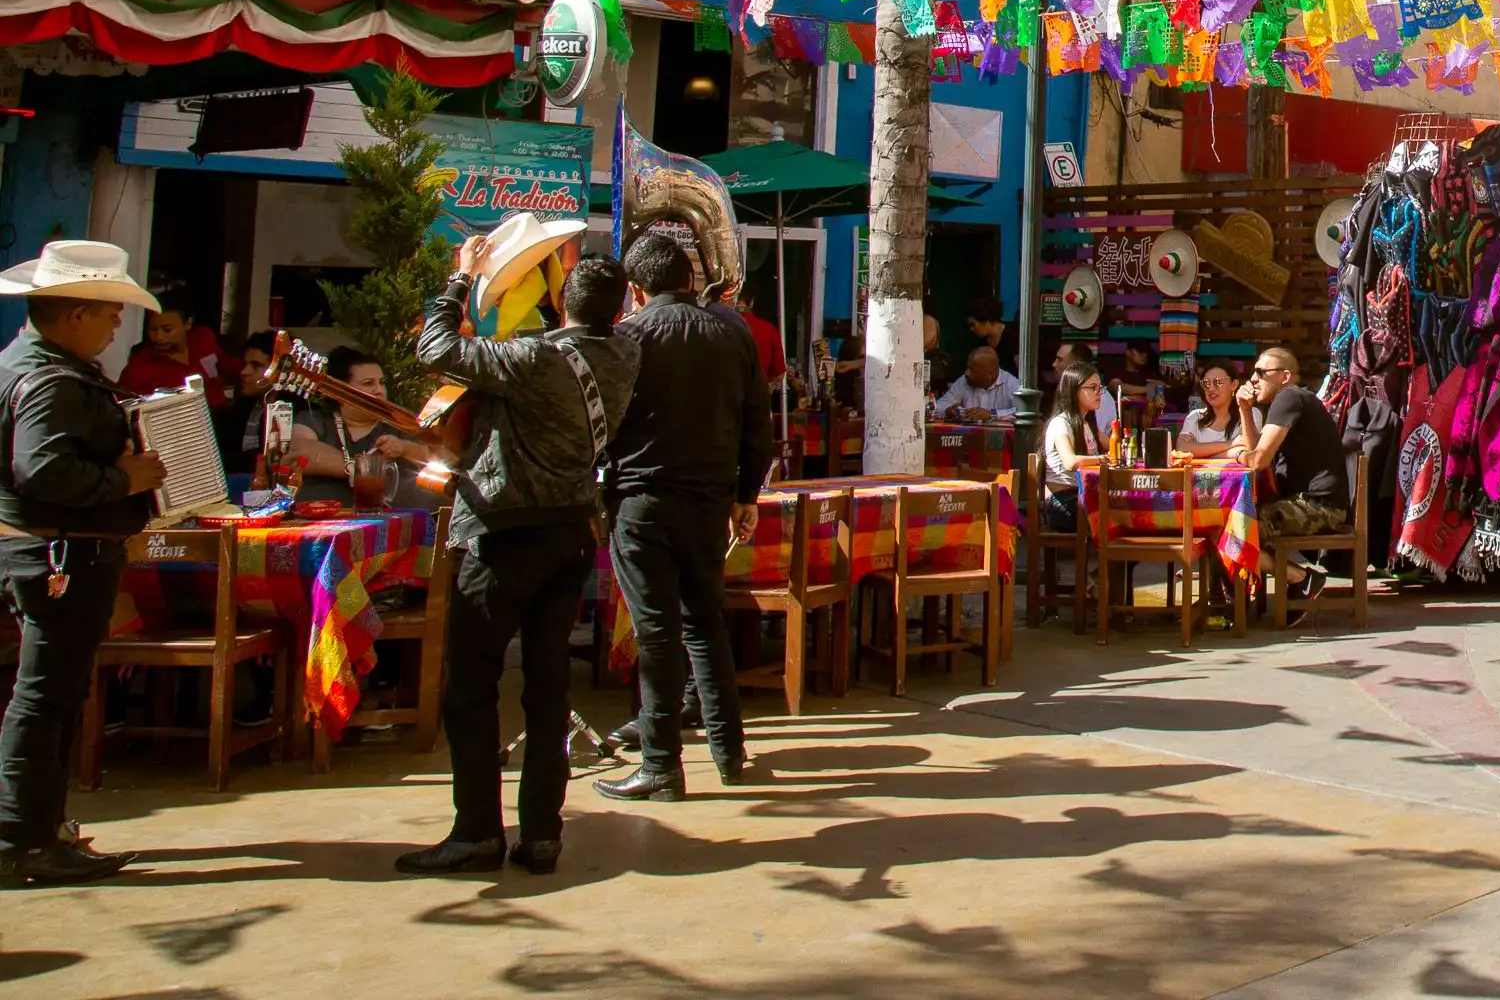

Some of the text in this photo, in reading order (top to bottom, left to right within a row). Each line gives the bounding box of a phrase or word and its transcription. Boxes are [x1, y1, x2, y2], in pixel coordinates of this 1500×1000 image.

[519, 140, 539, 150] Friday
[549, 142, 577, 154] Saturday
[1057, 159, 1071, 177] E
[455, 172, 580, 213] La Tradición
[941, 435, 963, 447] TECATE
[1132, 474, 1161, 489] TECATE
[819, 510, 837, 524] TECATE
[147, 545, 187, 559] TECATE
